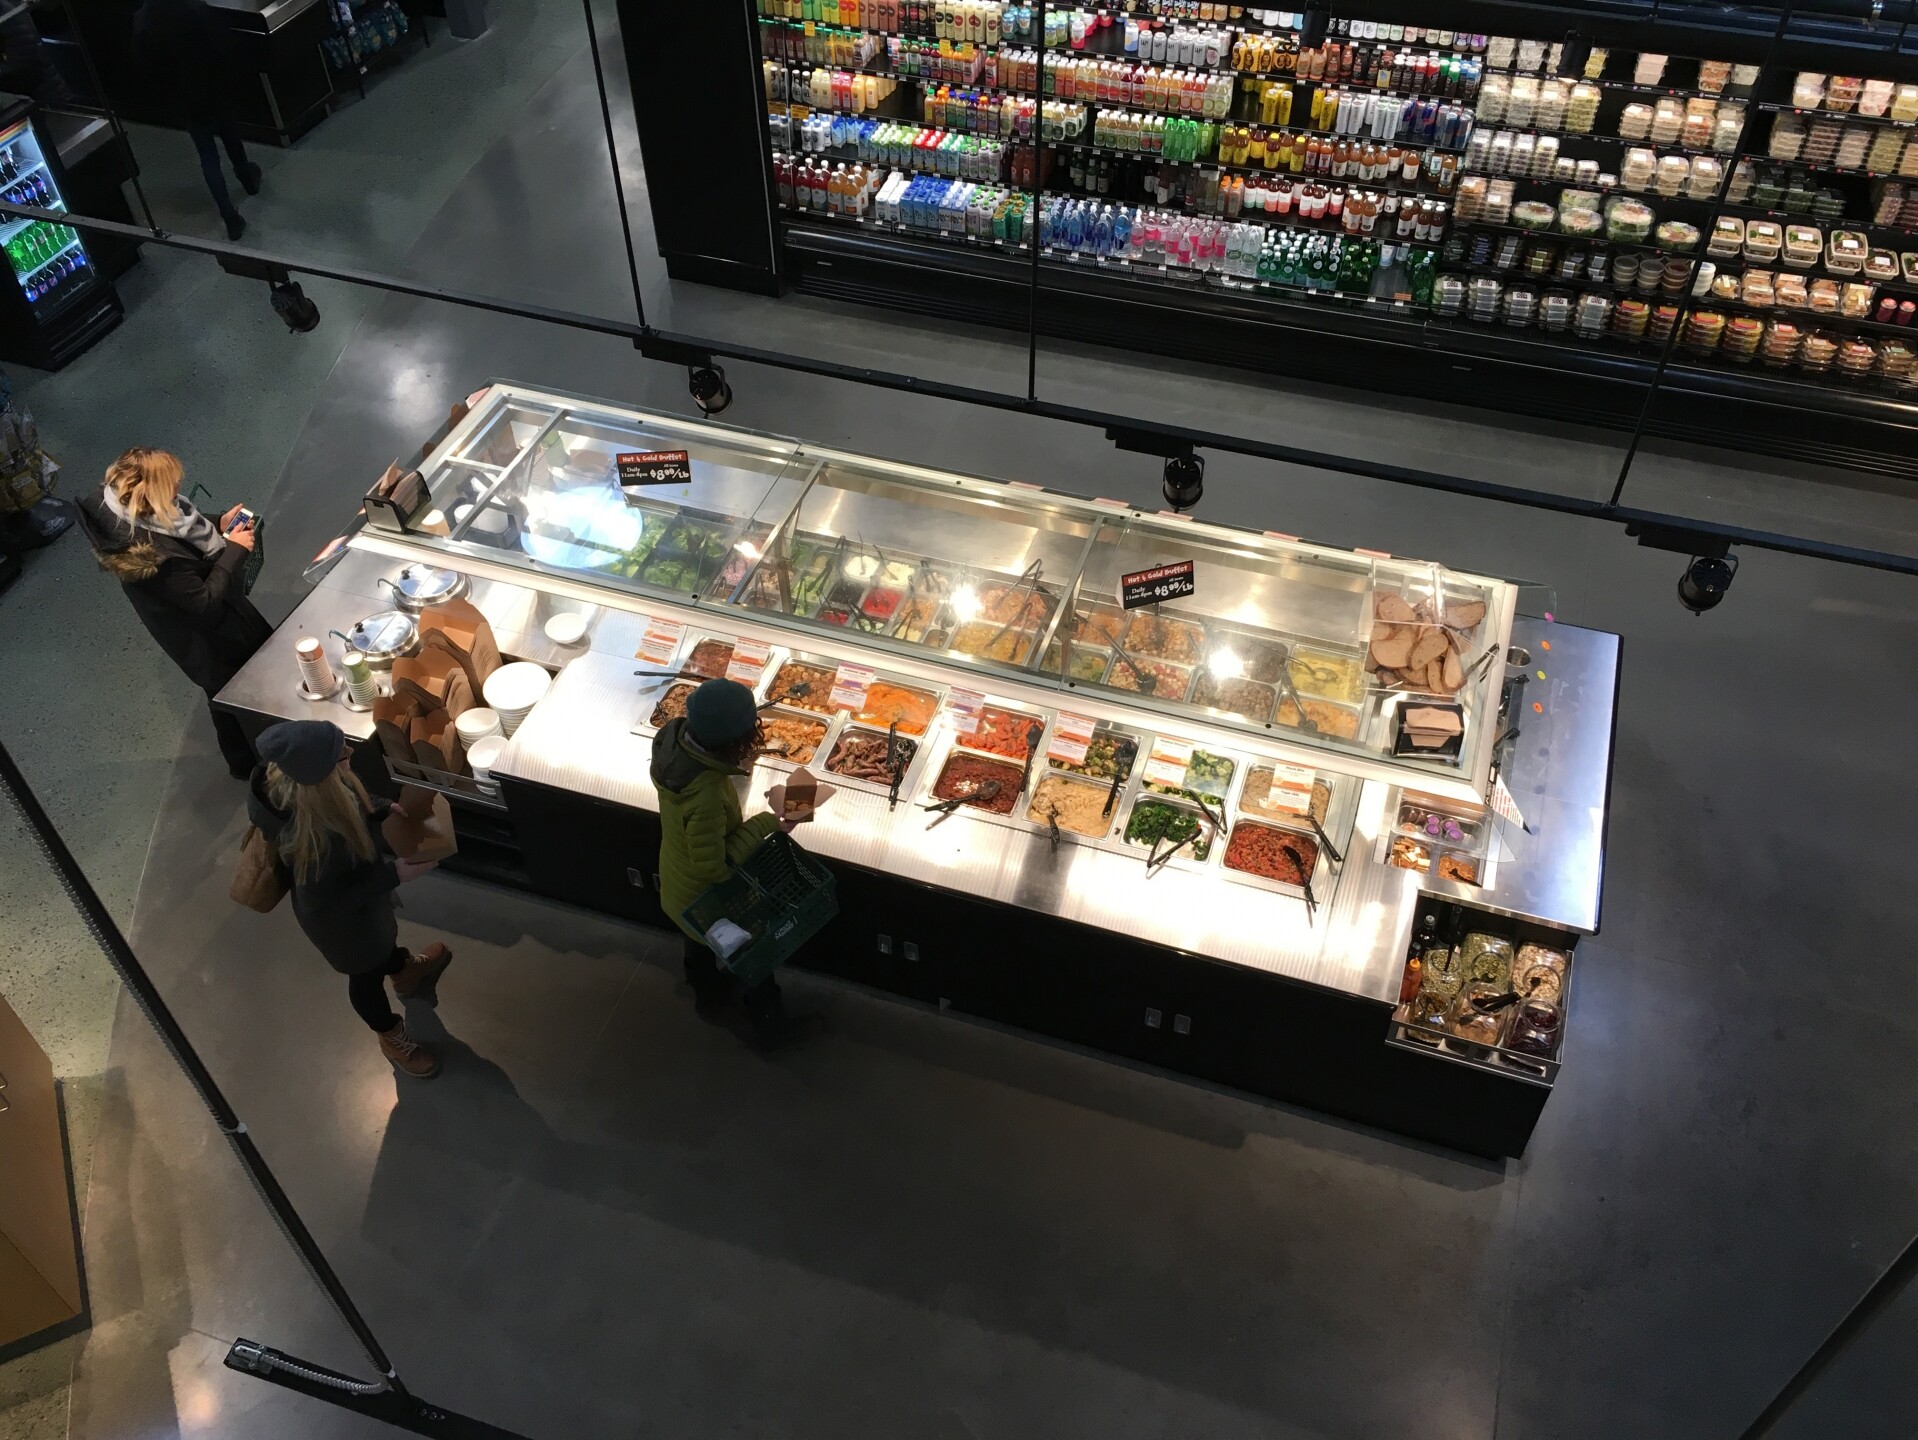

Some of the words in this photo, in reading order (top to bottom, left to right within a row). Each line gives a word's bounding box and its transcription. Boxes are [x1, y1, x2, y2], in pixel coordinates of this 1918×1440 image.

[659, 453, 682, 461] Buffet
[1127, 576, 1140, 584] Hot
[1147, 570, 1163, 579] Cold
[1164, 565, 1188, 576] Buffet
[1131, 586, 1146, 594] Daily
